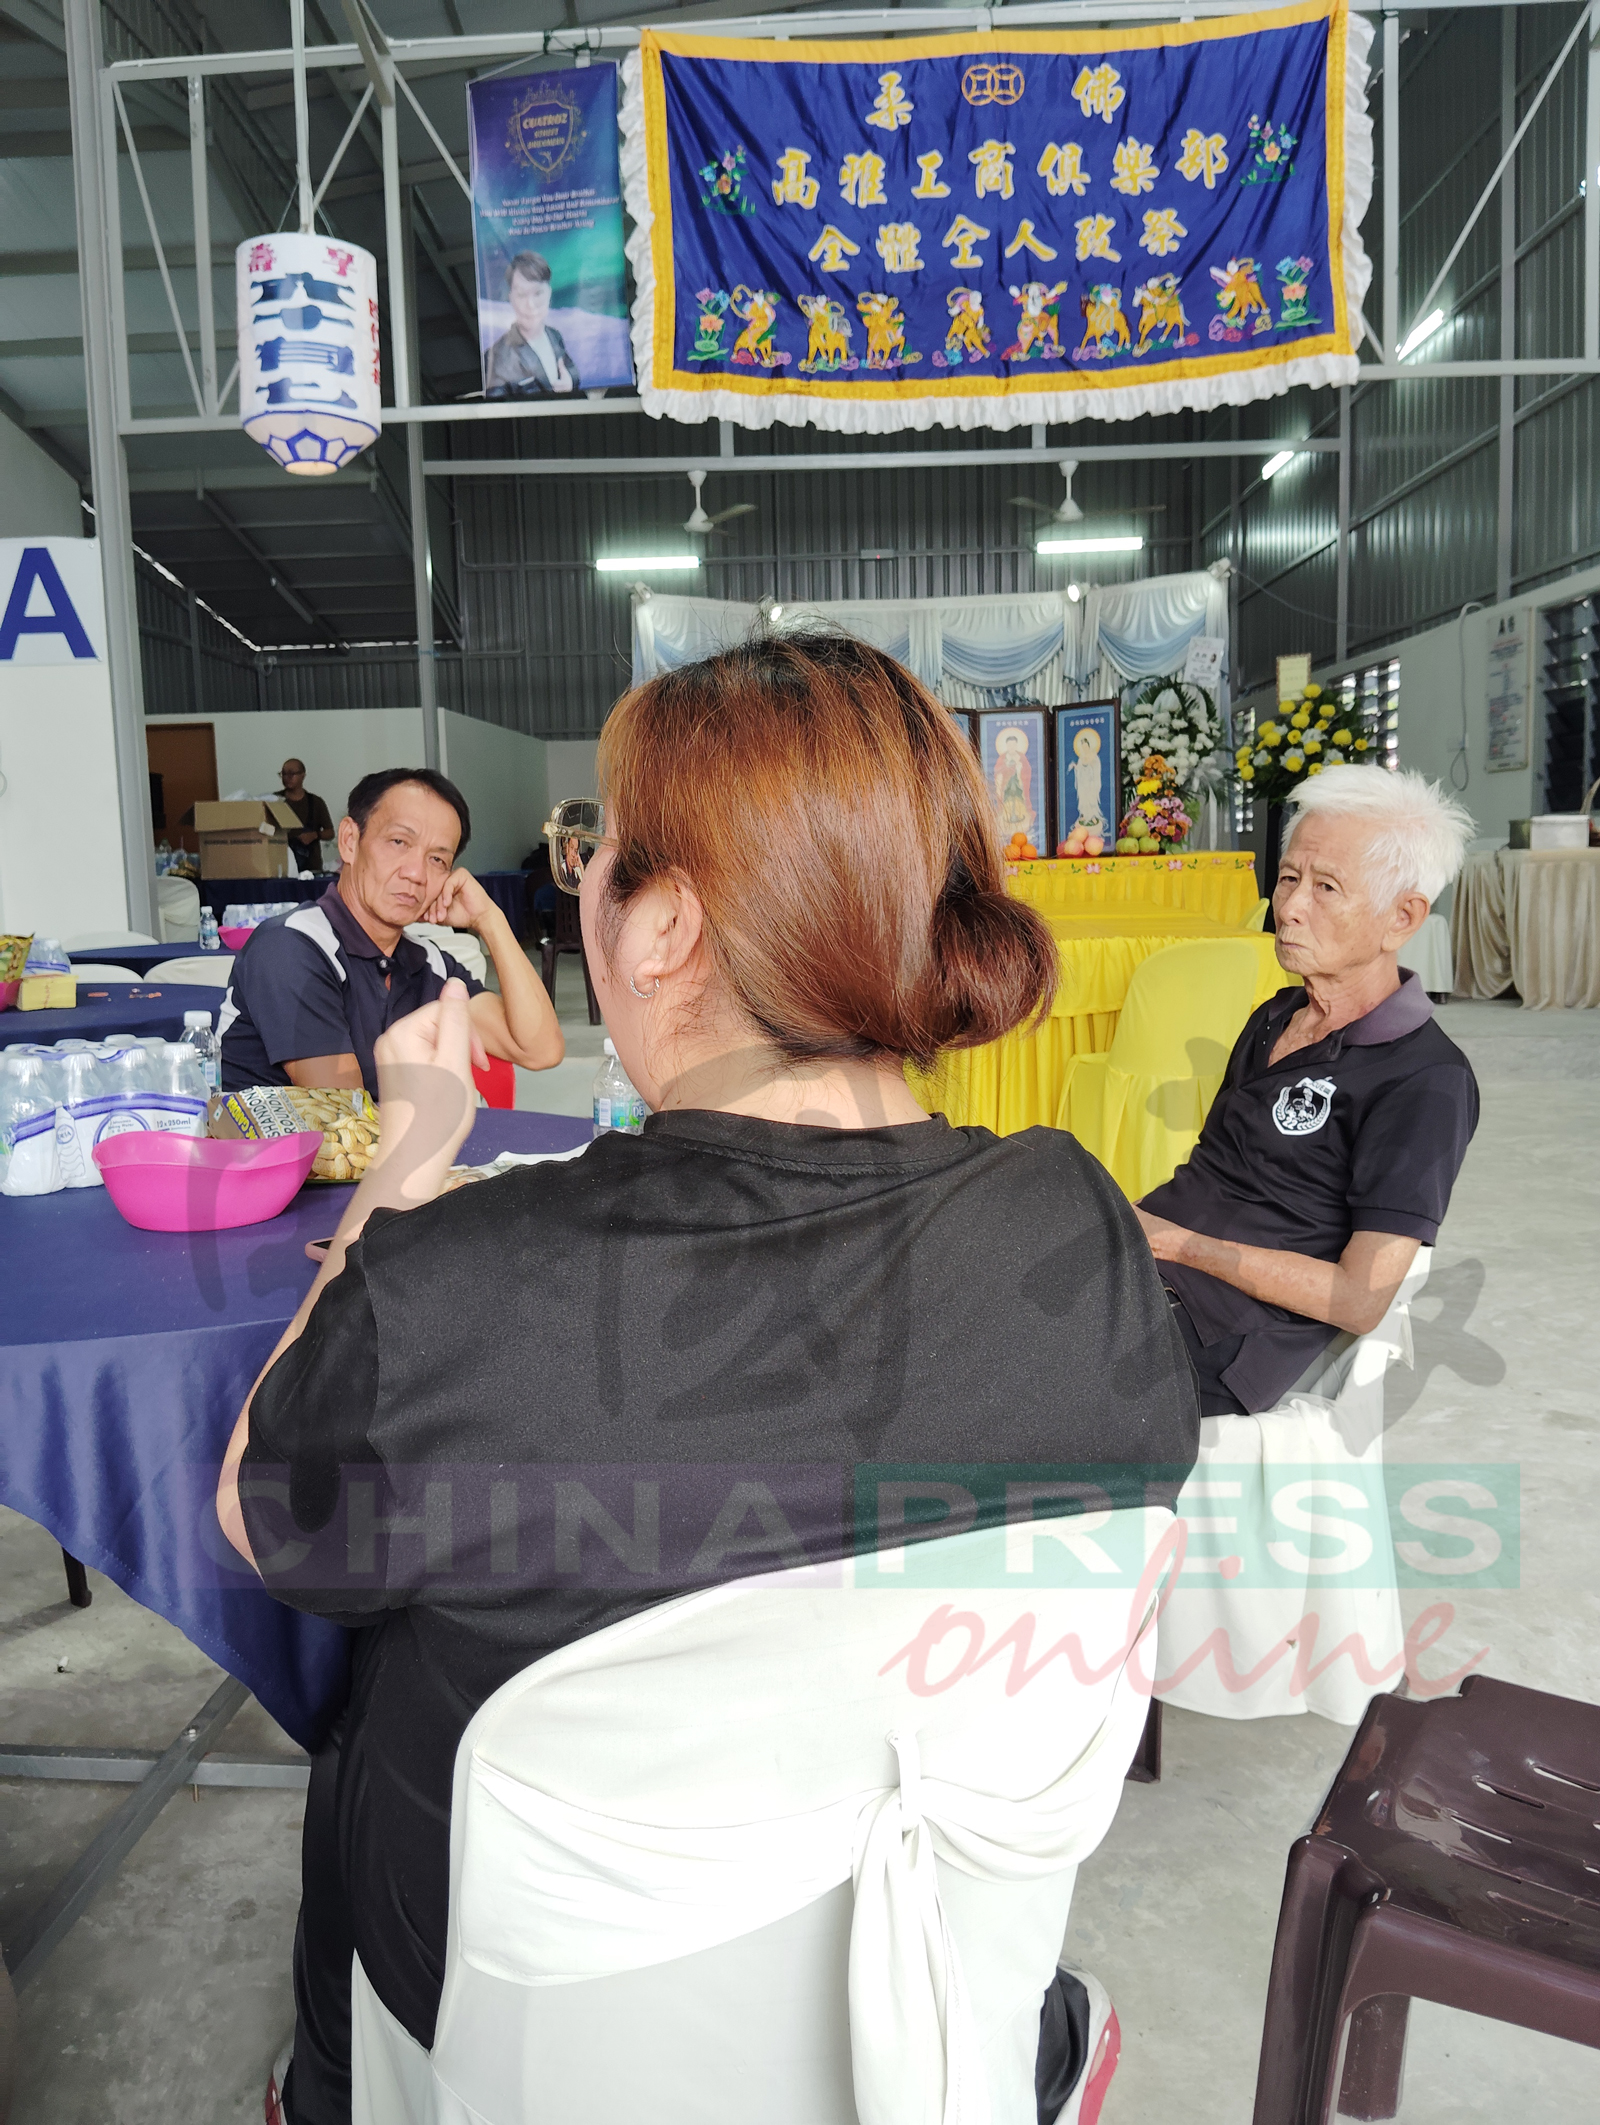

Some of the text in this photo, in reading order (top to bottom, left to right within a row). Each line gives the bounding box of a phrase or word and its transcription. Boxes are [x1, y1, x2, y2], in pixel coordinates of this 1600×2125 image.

[772, 128, 1230, 209] 高雅工商俱樂部
[0, 547, 97, 660] A
